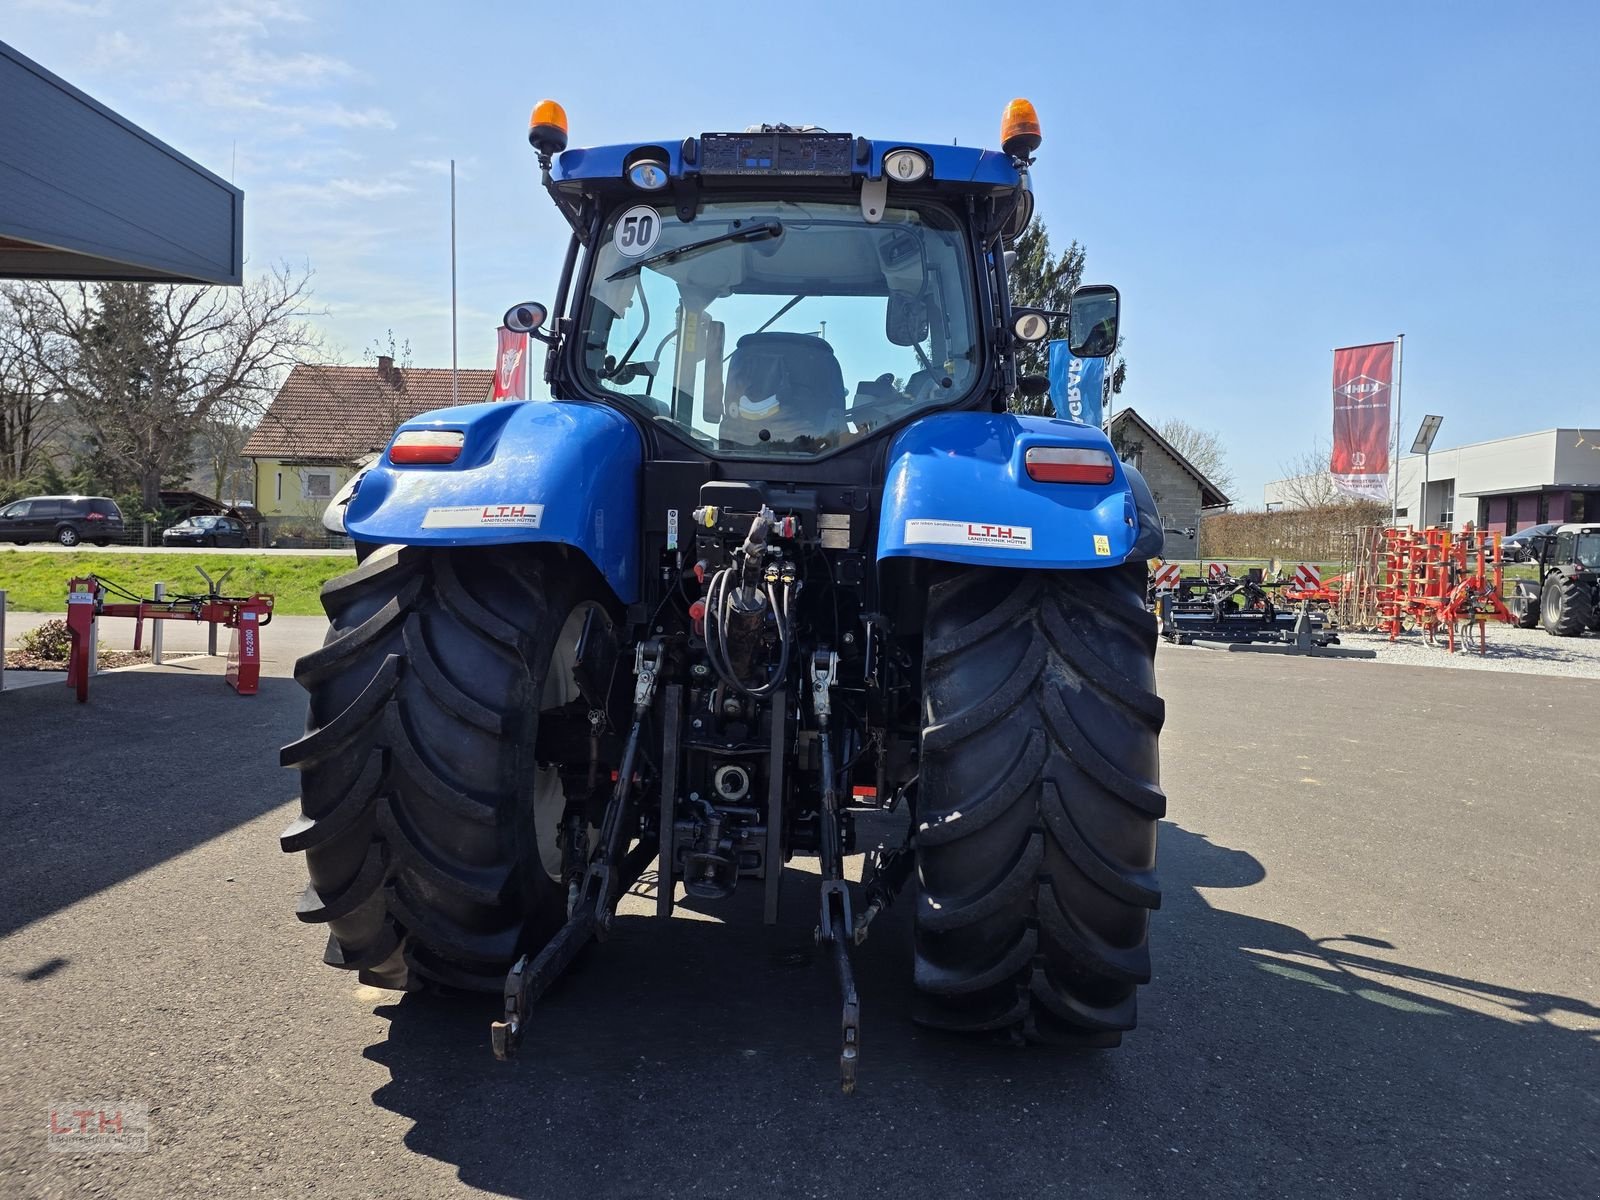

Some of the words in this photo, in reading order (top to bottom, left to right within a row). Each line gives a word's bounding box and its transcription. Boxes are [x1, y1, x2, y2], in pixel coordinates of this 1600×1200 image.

[621, 215, 653, 247] 50
[482, 506, 526, 518] LTH
[967, 524, 1012, 539] LTH
